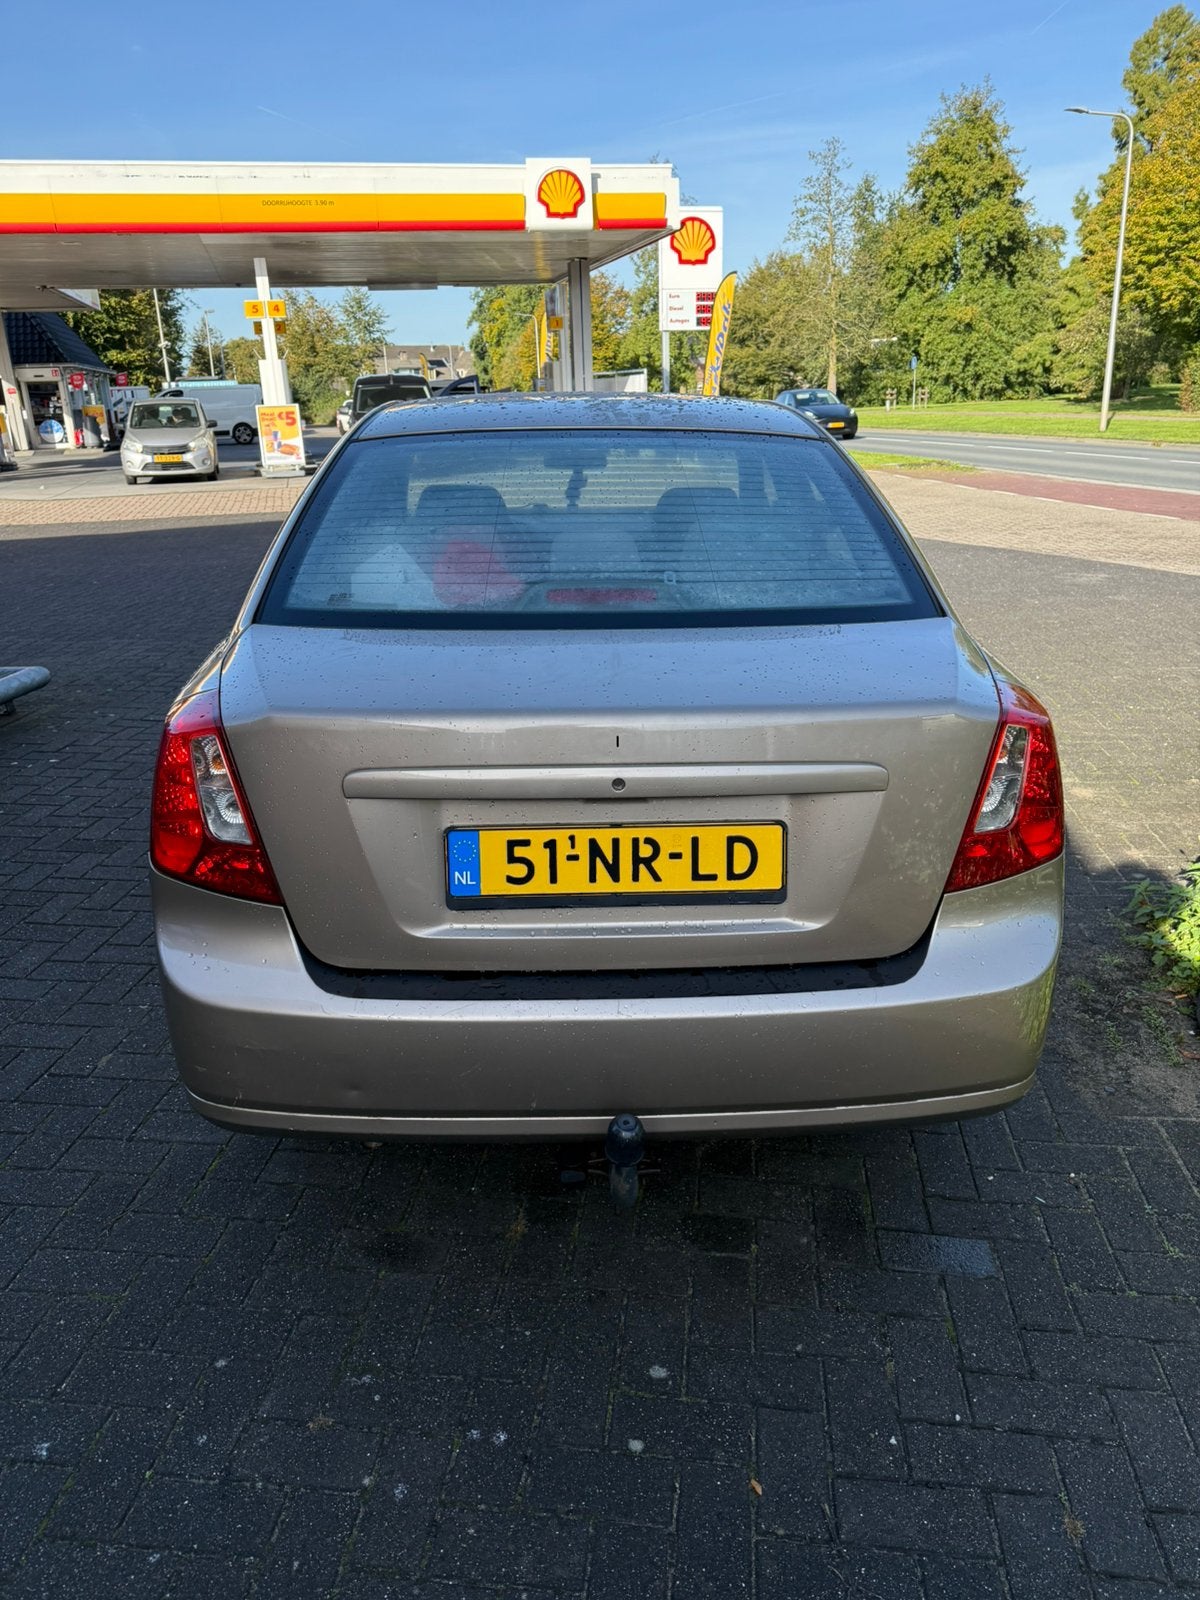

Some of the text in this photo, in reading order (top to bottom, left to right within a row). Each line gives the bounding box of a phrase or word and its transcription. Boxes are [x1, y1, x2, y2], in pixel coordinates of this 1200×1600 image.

[251, 304, 281, 314] 5 4
[454, 870, 477, 886] NL
